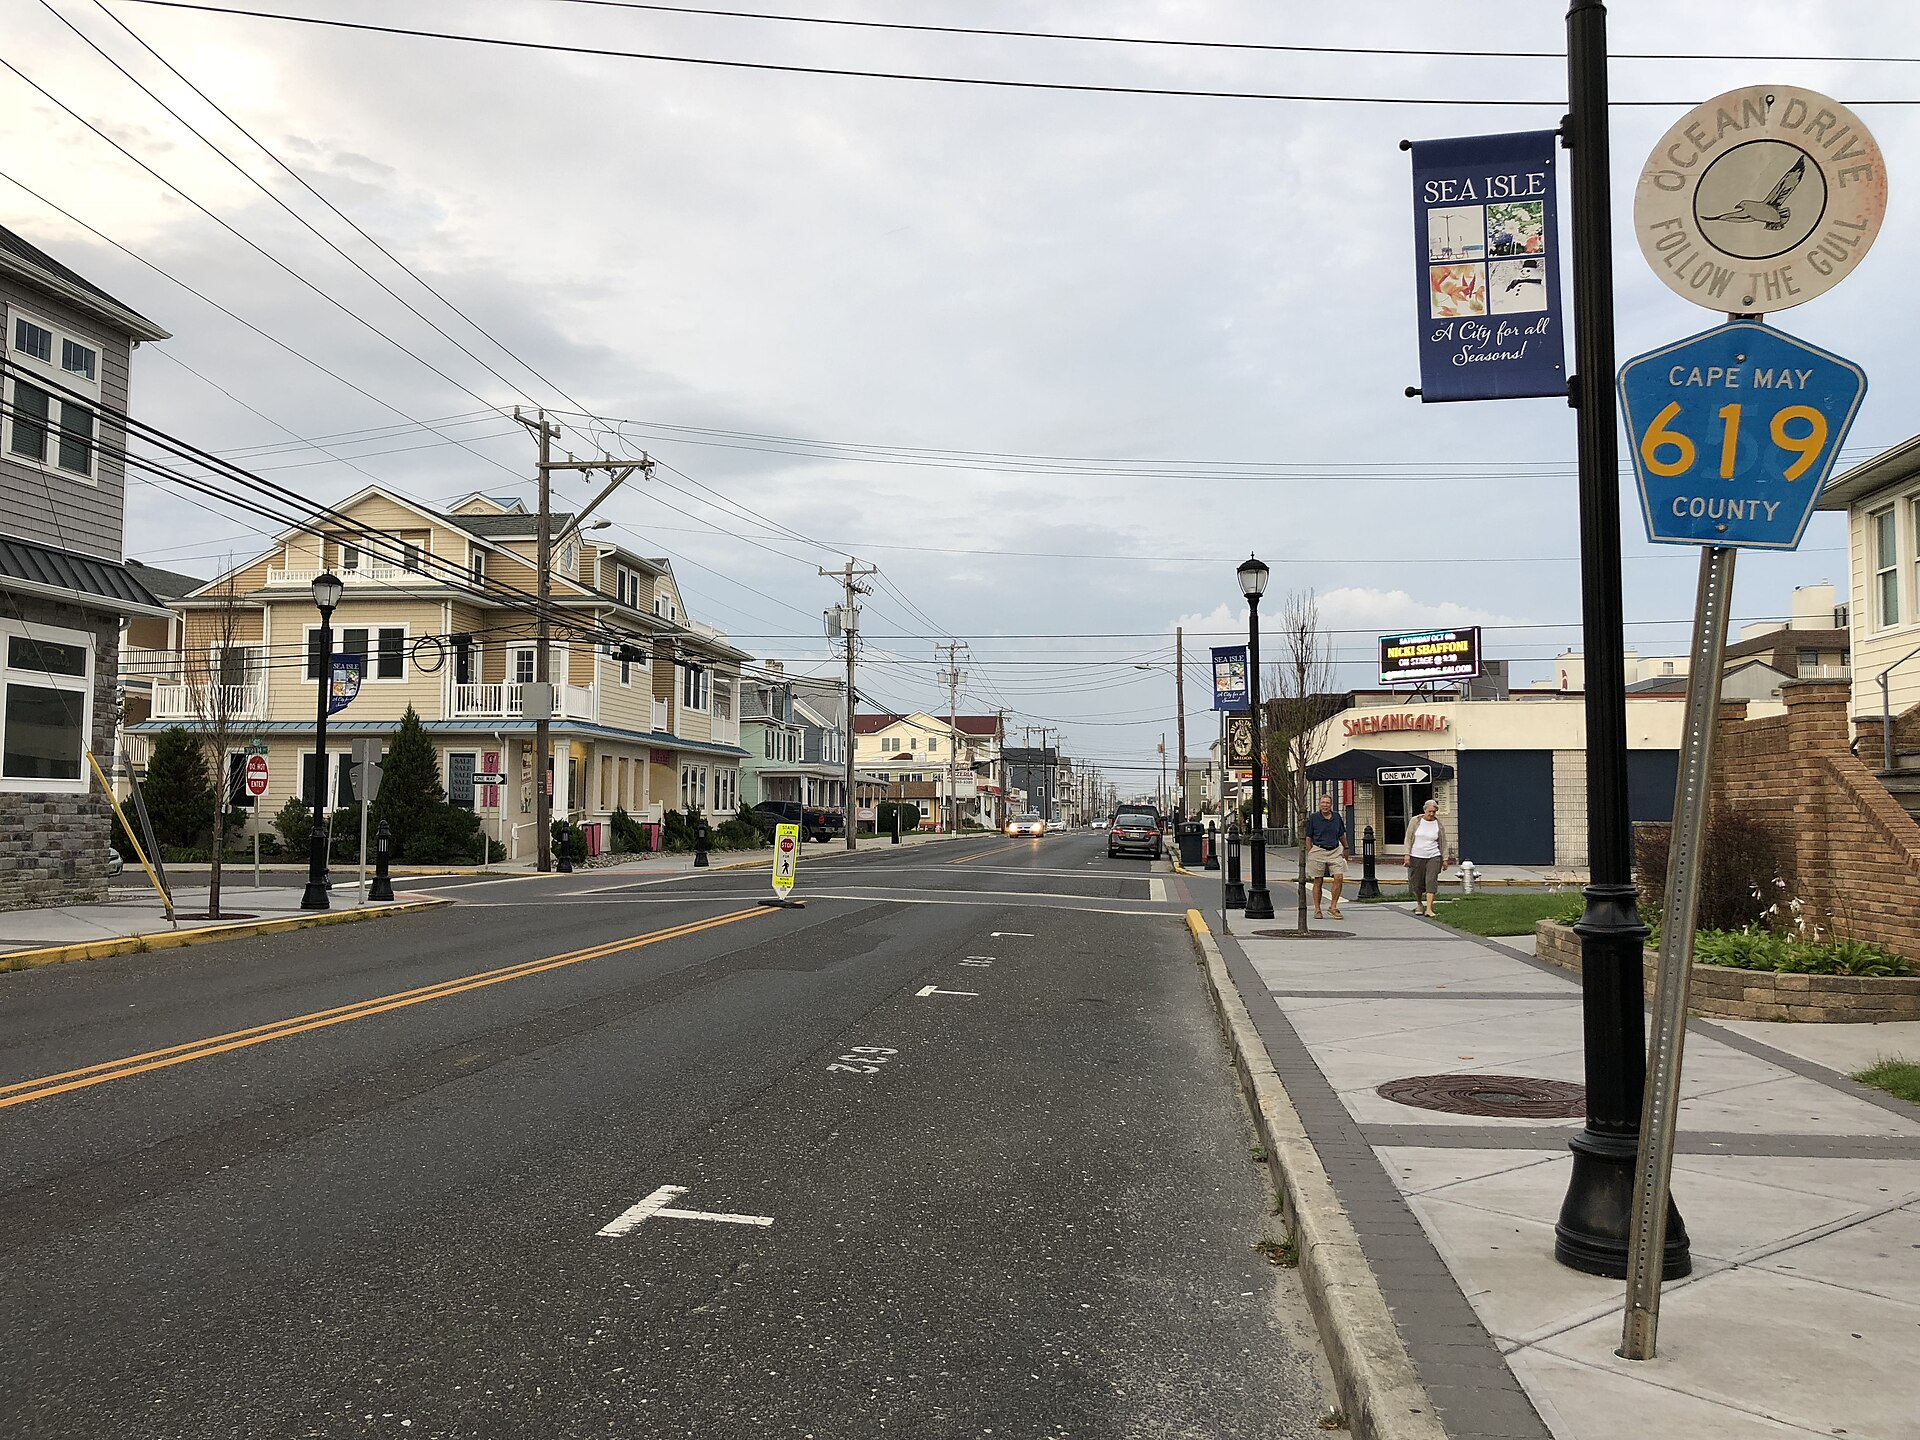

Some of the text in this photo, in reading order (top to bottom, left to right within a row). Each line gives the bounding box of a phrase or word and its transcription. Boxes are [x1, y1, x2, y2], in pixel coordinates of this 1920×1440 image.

[1653, 96, 1874, 192] OCEAN DRIVE
[1423, 172, 1546, 203] SEA ISLE
[1650, 216, 1869, 301] FOLLOW THE GULL
[1431, 317, 1550, 349] A City for all
[1452, 340, 1528, 366] Seasons!
[1668, 365, 1813, 390] CAPE MAY
[1640, 400, 1828, 482] 619
[1672, 496, 1781, 522] COUNTY
[1399, 636, 1430, 645] SATURDAY
[1431, 633, 1445, 642] OCT
[1399, 658, 1409, 667] ON
[1411, 656, 1433, 666] STAGE
[1443, 665, 1472, 674] SALOON
[1230, 720, 1244, 734] DEAD
[1342, 713, 1446, 737] SHENANIGANS
[1400, 771, 1415, 779] WAY
